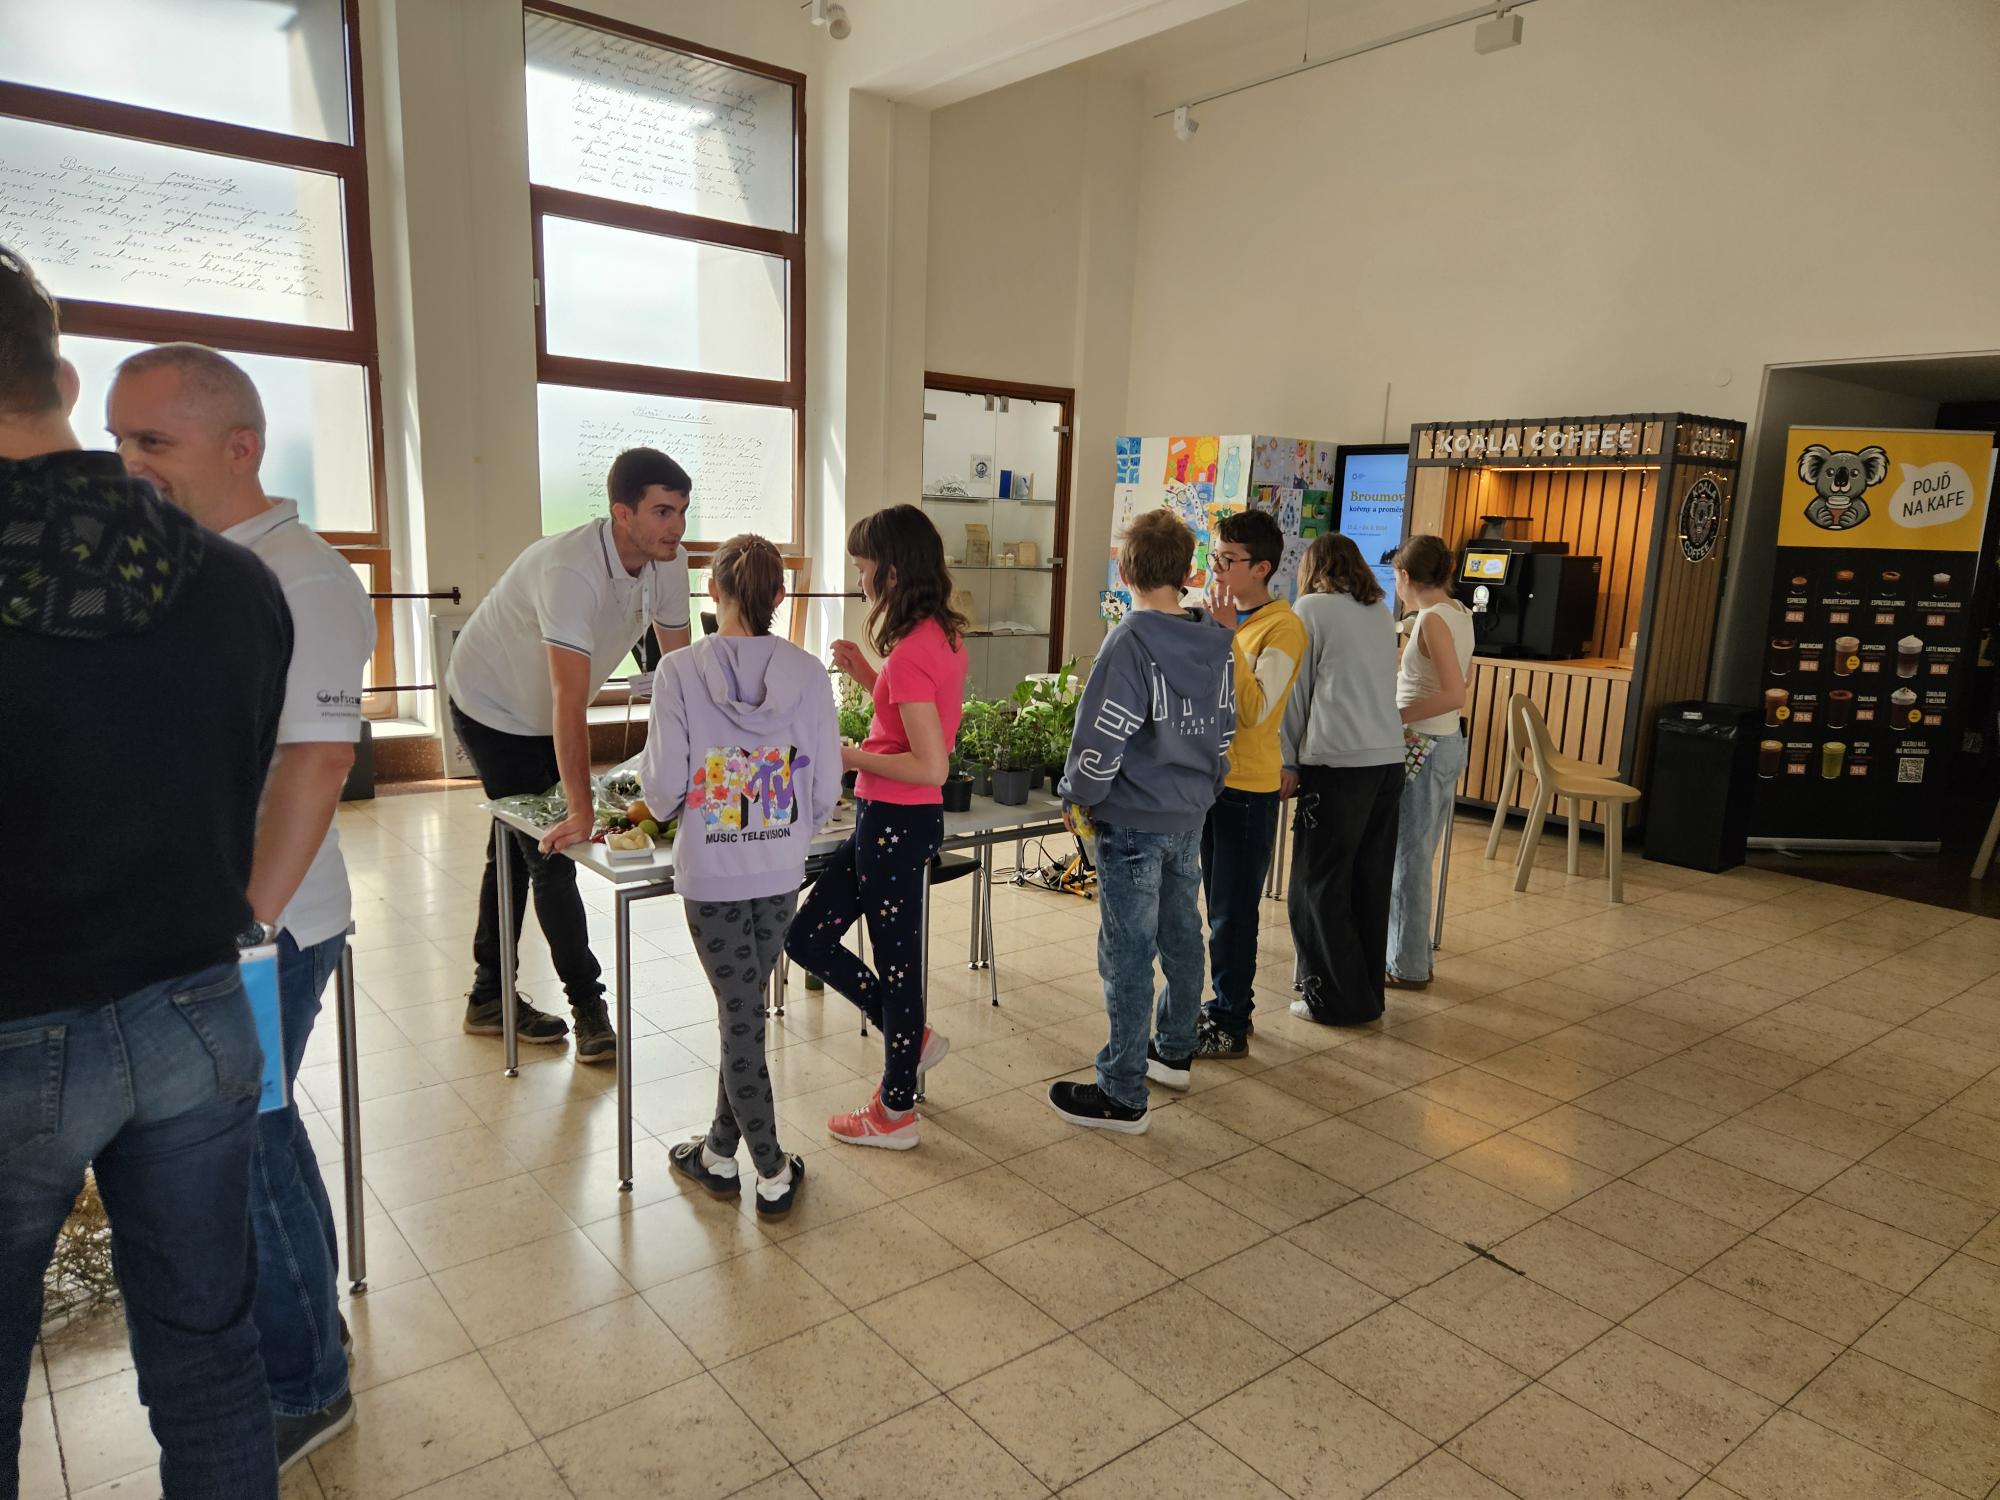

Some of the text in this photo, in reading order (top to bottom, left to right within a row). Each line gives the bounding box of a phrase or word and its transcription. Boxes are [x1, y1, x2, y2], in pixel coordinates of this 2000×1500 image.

[1439, 429, 1634, 453] KOALA COFFEE
[1692, 482, 1717, 499] KOALA
[1912, 470, 1951, 496] POJĎ
[1903, 490, 1966, 517] NA KAFE
[1684, 540, 1711, 559] COFFEE
[1171, 716, 1215, 728] YOUNG
[705, 833, 738, 845] MUSIC
[741, 828, 791, 842] TELEVISION
